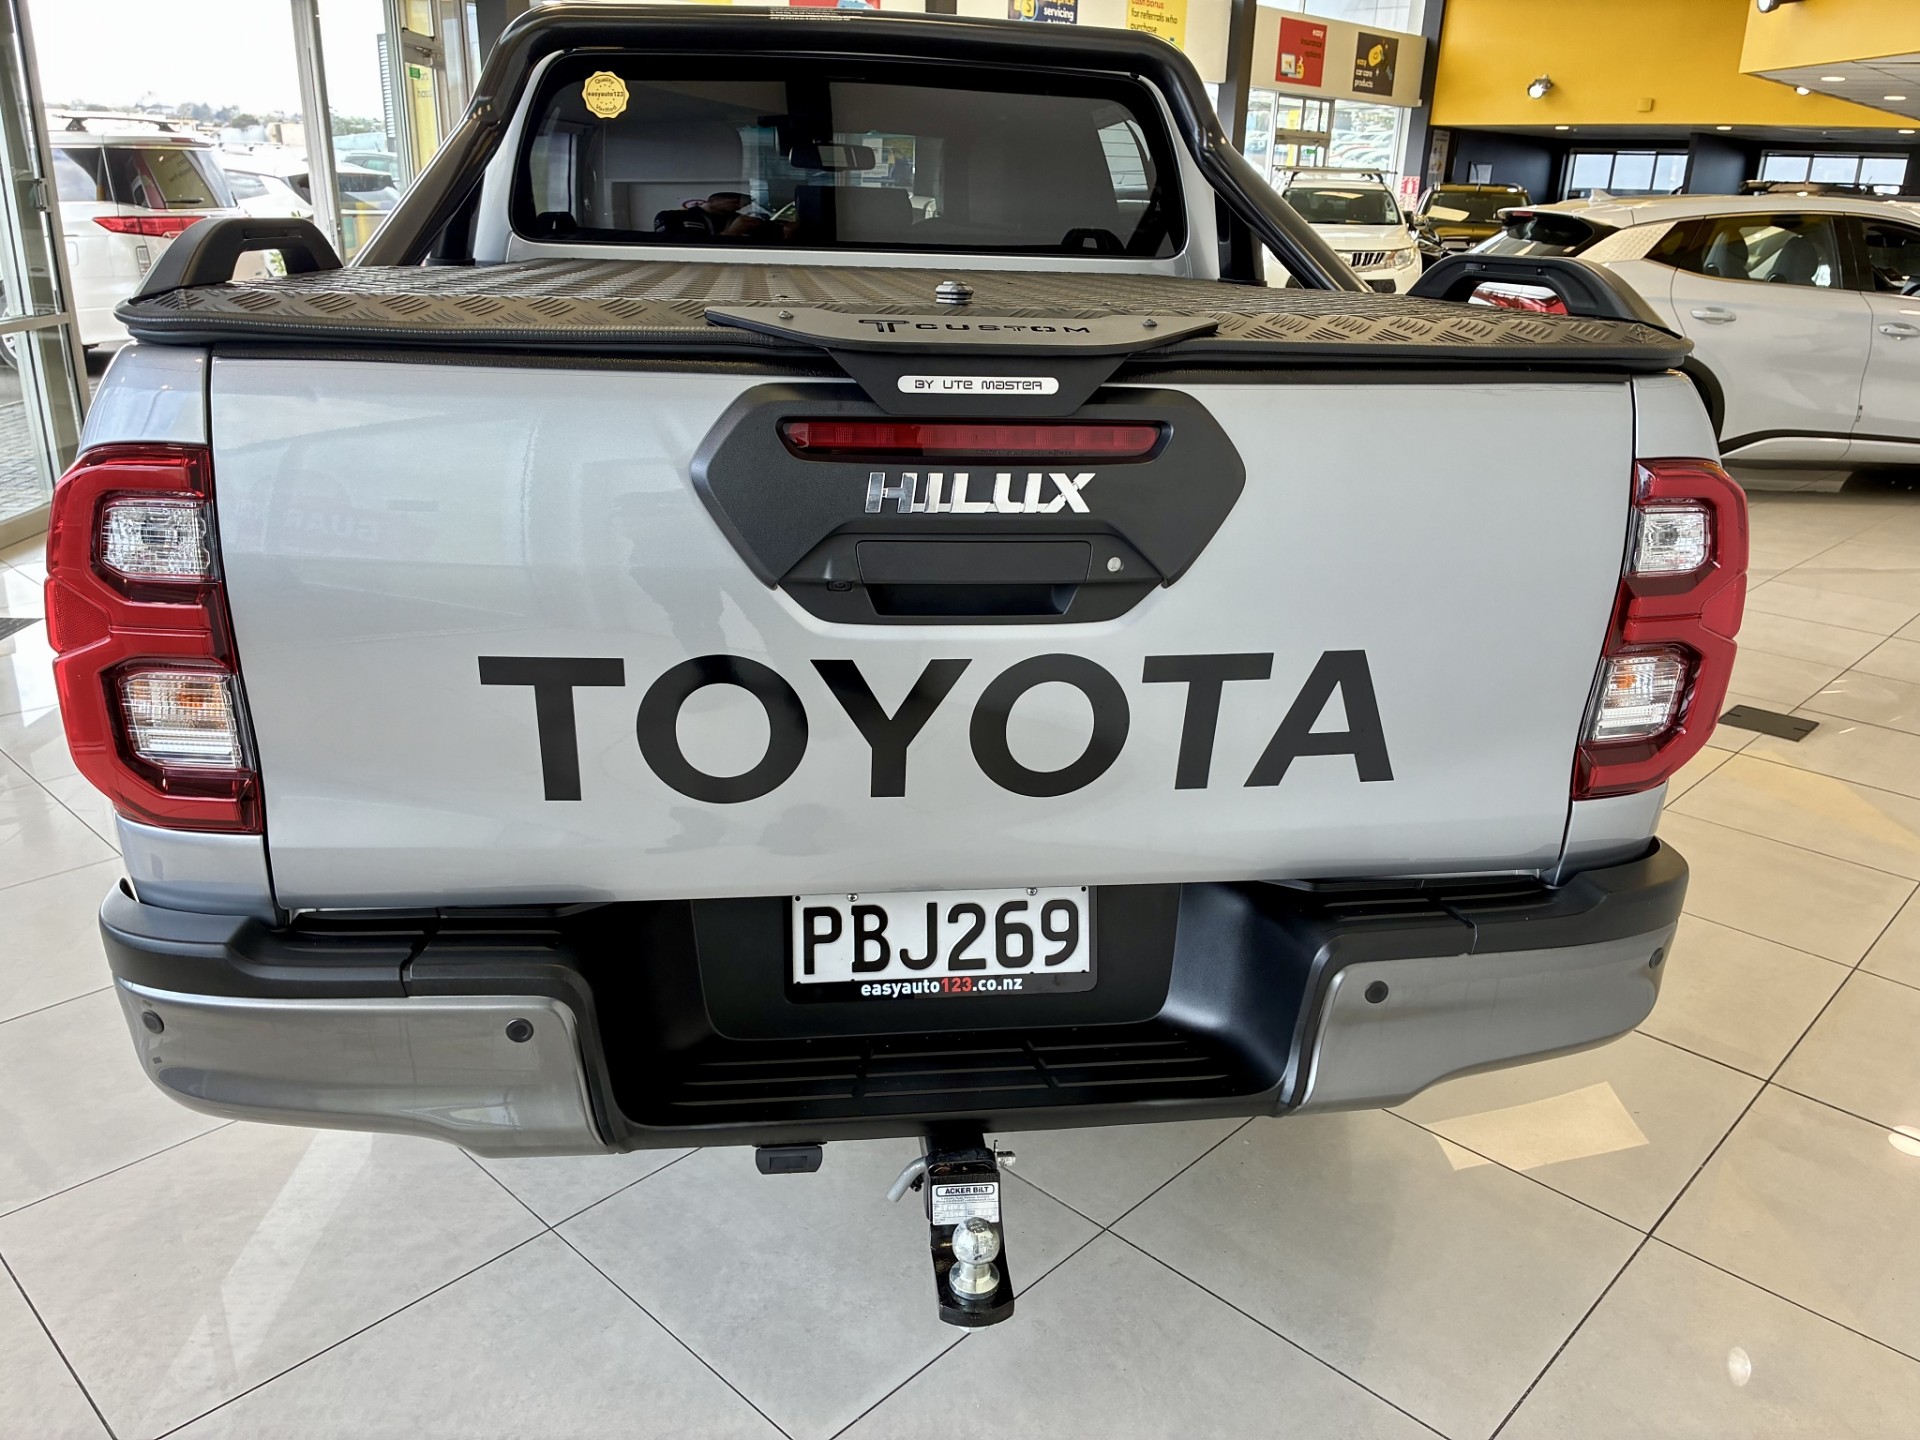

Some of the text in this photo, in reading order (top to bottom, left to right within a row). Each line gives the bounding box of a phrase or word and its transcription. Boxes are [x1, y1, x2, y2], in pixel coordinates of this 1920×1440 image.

[1043, 6, 1075, 21] servicing
[1131, 7, 1179, 24] for referrals who
[1354, 78, 1374, 88] products
[595, 104, 617, 112] Verified
[915, 323, 1091, 334] CUSTOM
[914, 379, 934, 389] BY
[864, 471, 1096, 514] HILUX
[478, 649, 1395, 805] TOYOTA
[803, 898, 1079, 975] PBJ269
[860, 976, 1023, 999] easyauto123.co.nz
[945, 1187, 971, 1195] ACKER
